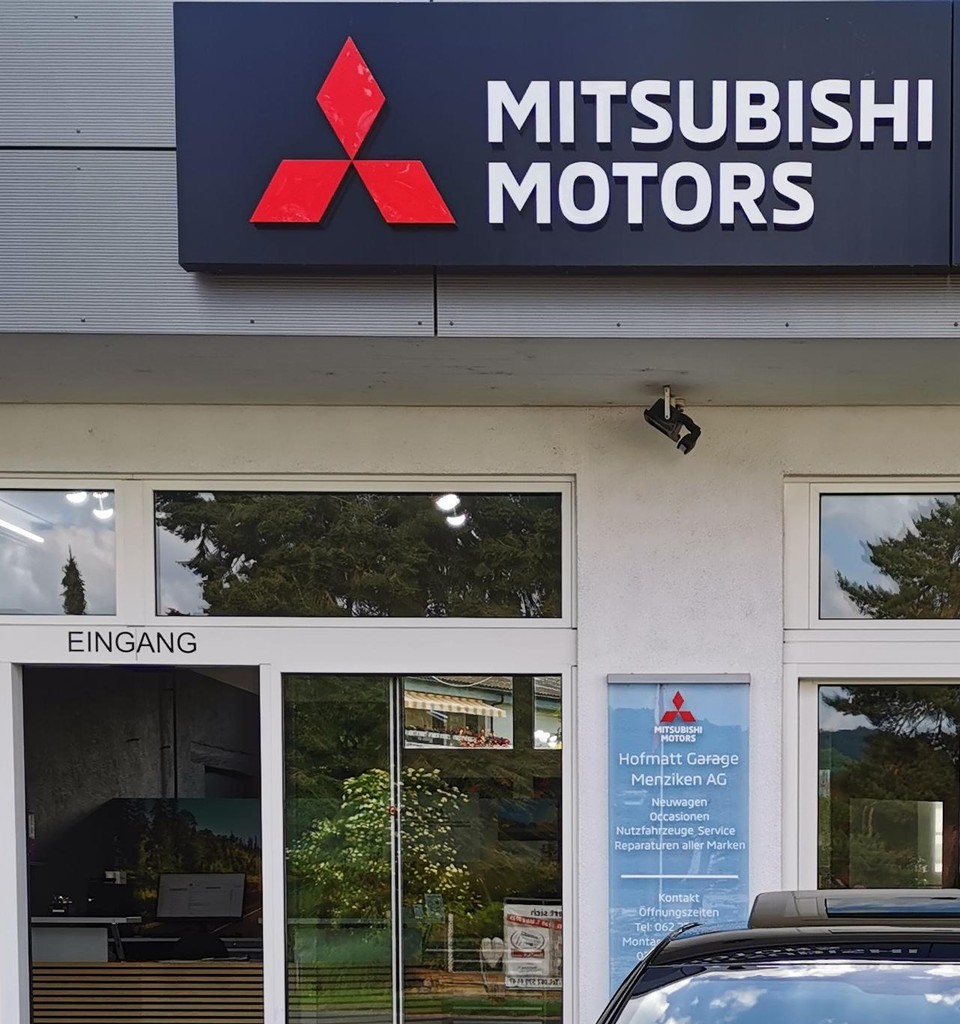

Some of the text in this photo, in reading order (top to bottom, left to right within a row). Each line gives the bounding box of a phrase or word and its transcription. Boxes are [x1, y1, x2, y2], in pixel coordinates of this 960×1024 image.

[487, 79, 934, 145] MITSUBISHI
[488, 161, 815, 226] MOTORS
[68, 631, 197, 654] EINGANG
[654, 726, 703, 734] MITSUBISHI
[660, 734, 697, 742] MOTORS
[619, 752, 739, 768] Hofmatt Garage
[631, 773, 727, 786] Menziken AG
[651, 798, 708, 809] Neuwagen
[650, 812, 710, 822] Occasionen
[616, 826, 736, 837] Nutzfahrzeuge Service
[614, 841, 746, 852] Reparaturen aller Marken
[659, 893, 700, 903] Kontakt
[639, 906, 720, 919] Öffnungszeiten
[634, 922, 652, 932] Tel:
[654, 922, 675, 932] 062
